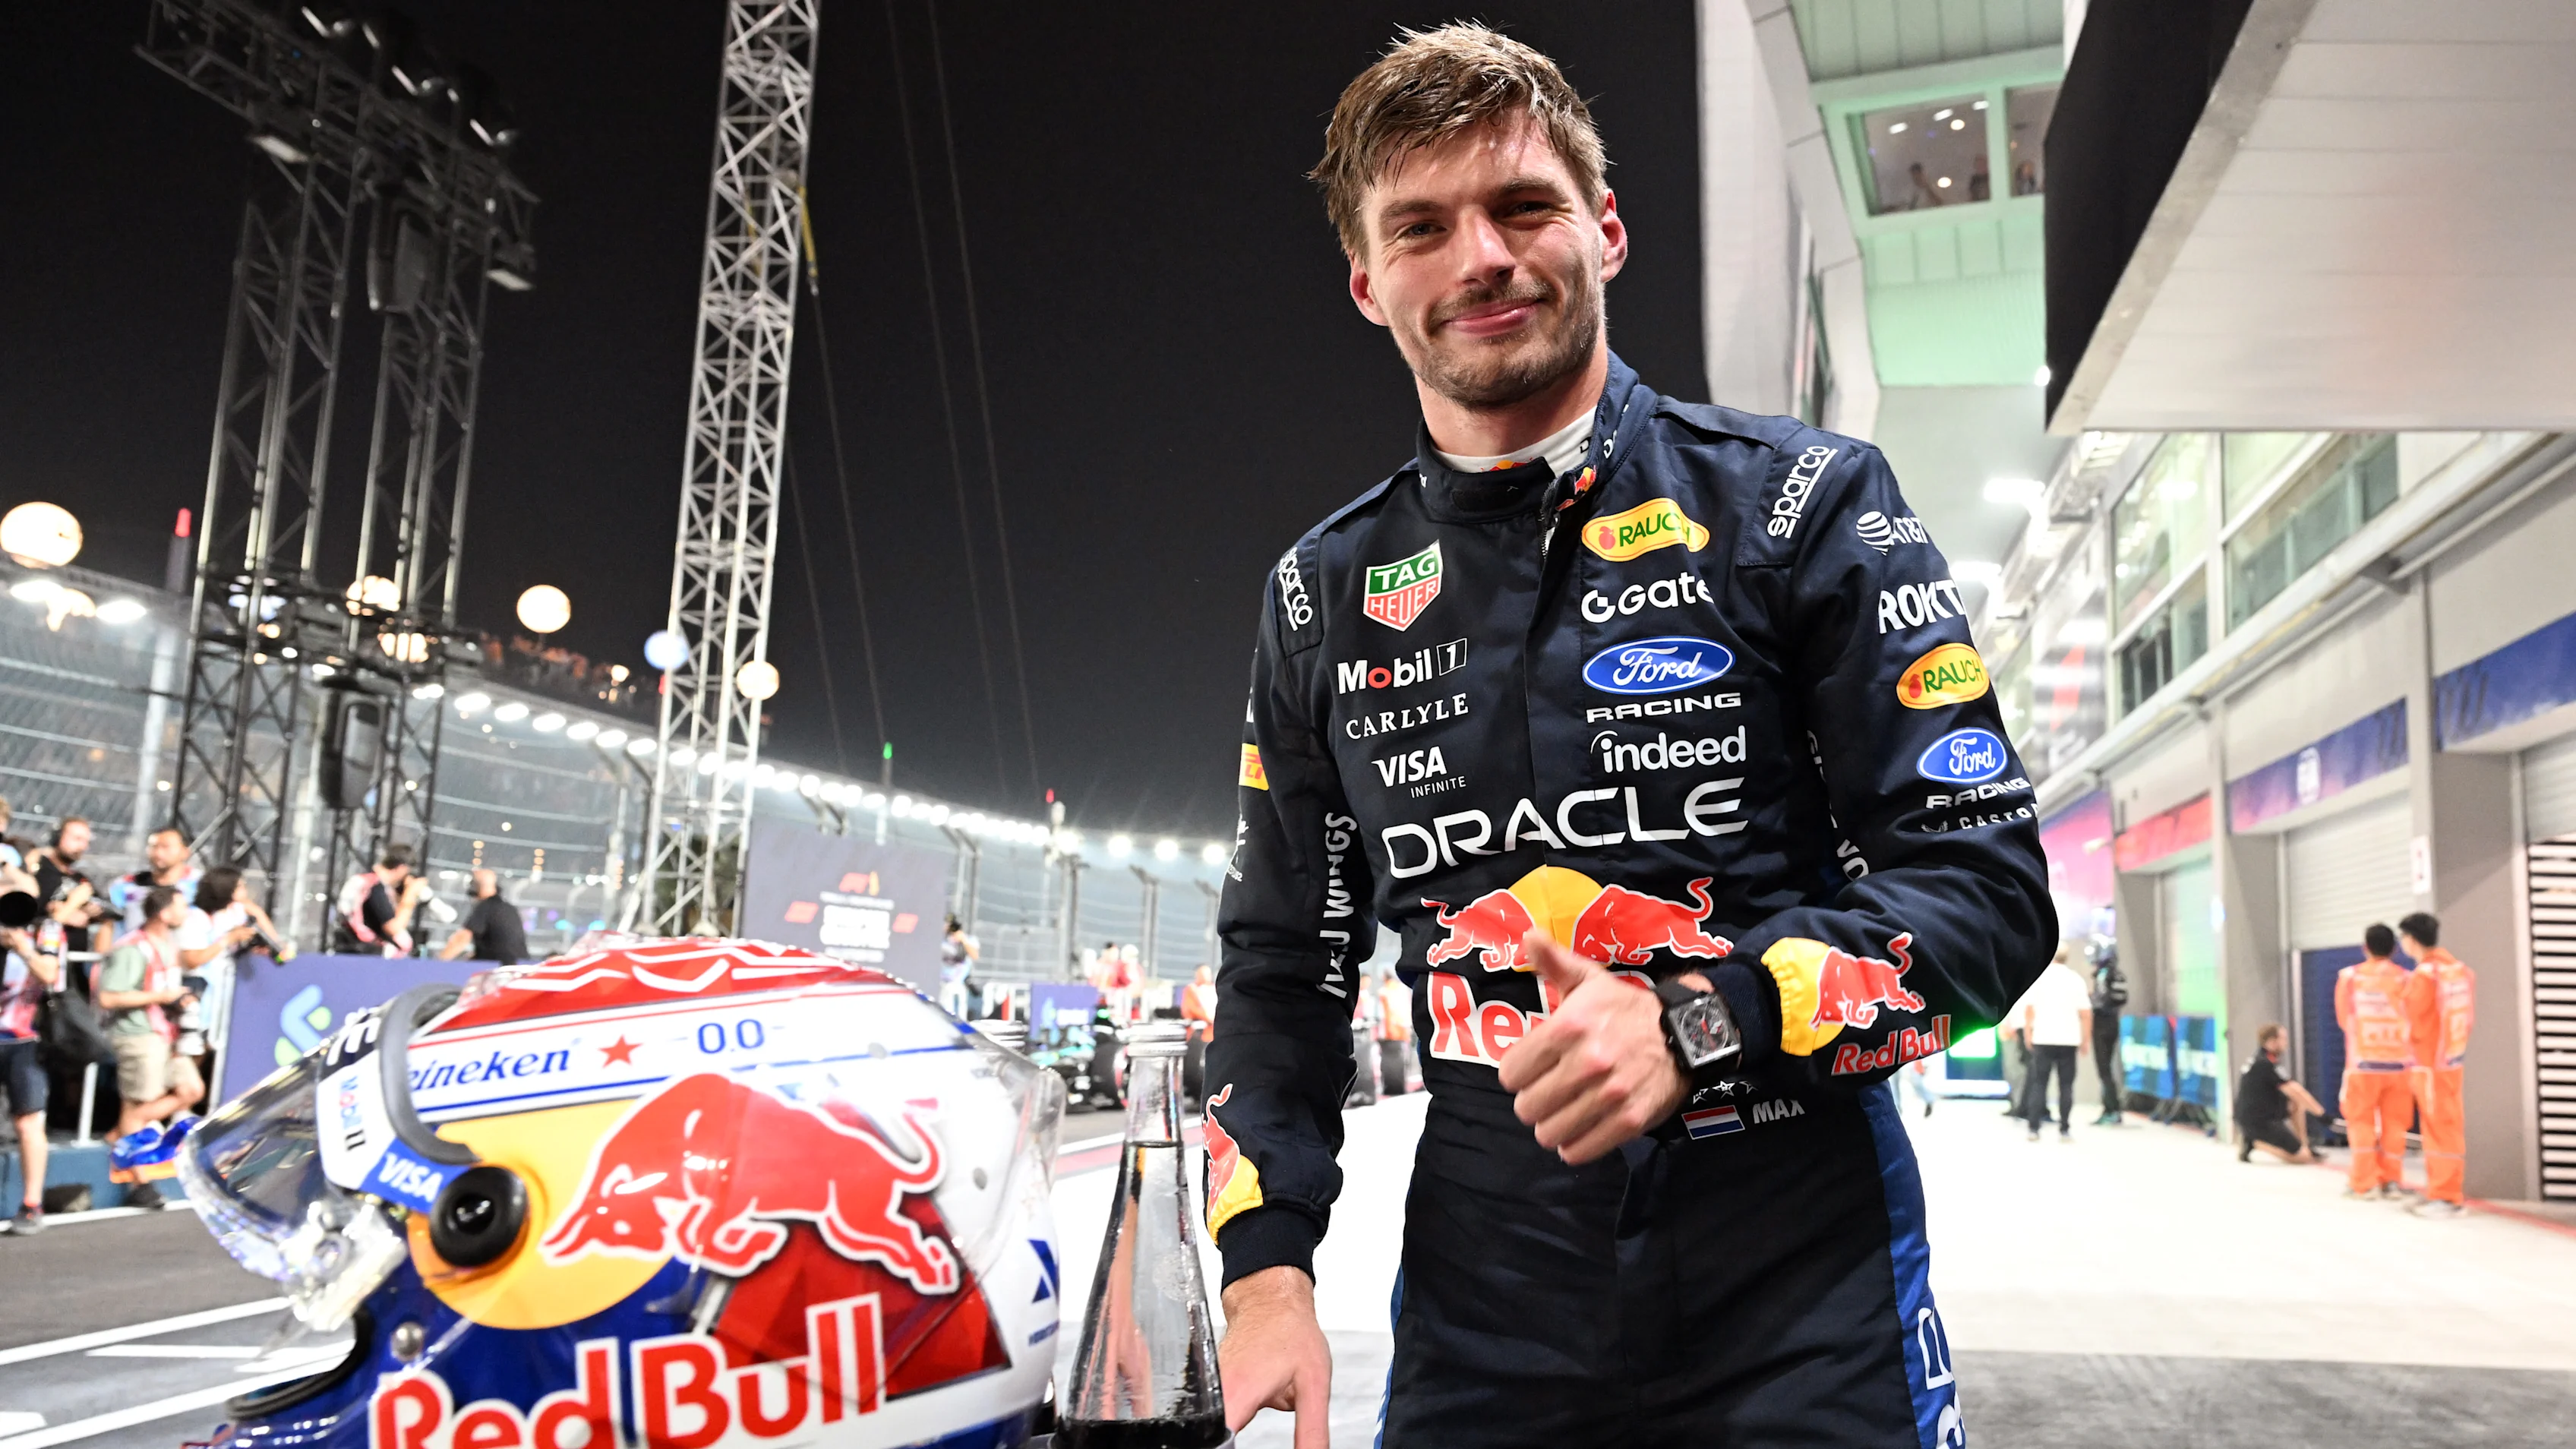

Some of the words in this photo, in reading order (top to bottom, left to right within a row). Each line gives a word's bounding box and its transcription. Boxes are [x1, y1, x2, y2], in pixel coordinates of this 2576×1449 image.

[1766, 446, 1832, 539] sparco
[1889, 516, 1929, 545] AT&T
[1277, 547, 1314, 627] sparco
[1374, 553, 1436, 591] TAG
[1370, 579, 1438, 625] HEUER
[1877, 579, 1966, 635] ROKT
[1337, 648, 1433, 694] Mobil
[1612, 646, 1703, 687] Ford
[1923, 659, 1984, 693] RAUCH
[1345, 692, 1469, 740] CARLYLE
[1586, 692, 1742, 724] RACING
[1370, 746, 1448, 788] VISA
[1601, 724, 1747, 773] indeed
[1948, 736, 1997, 776] Ford
[1410, 775, 1467, 799] INFINITE
[1925, 776, 2031, 810] RACING
[1381, 777, 1749, 880] ORACLE
[1427, 971, 1563, 1063] Re
[408, 1046, 571, 1092] eineken
[697, 1018, 766, 1054] 0.0
[1832, 1031, 1898, 1076] Red
[1899, 1015, 1952, 1064] Bull
[1752, 1099, 1805, 1125] MAX
[377, 1151, 444, 1204] VISA
[639, 1300, 879, 1449] Bull
